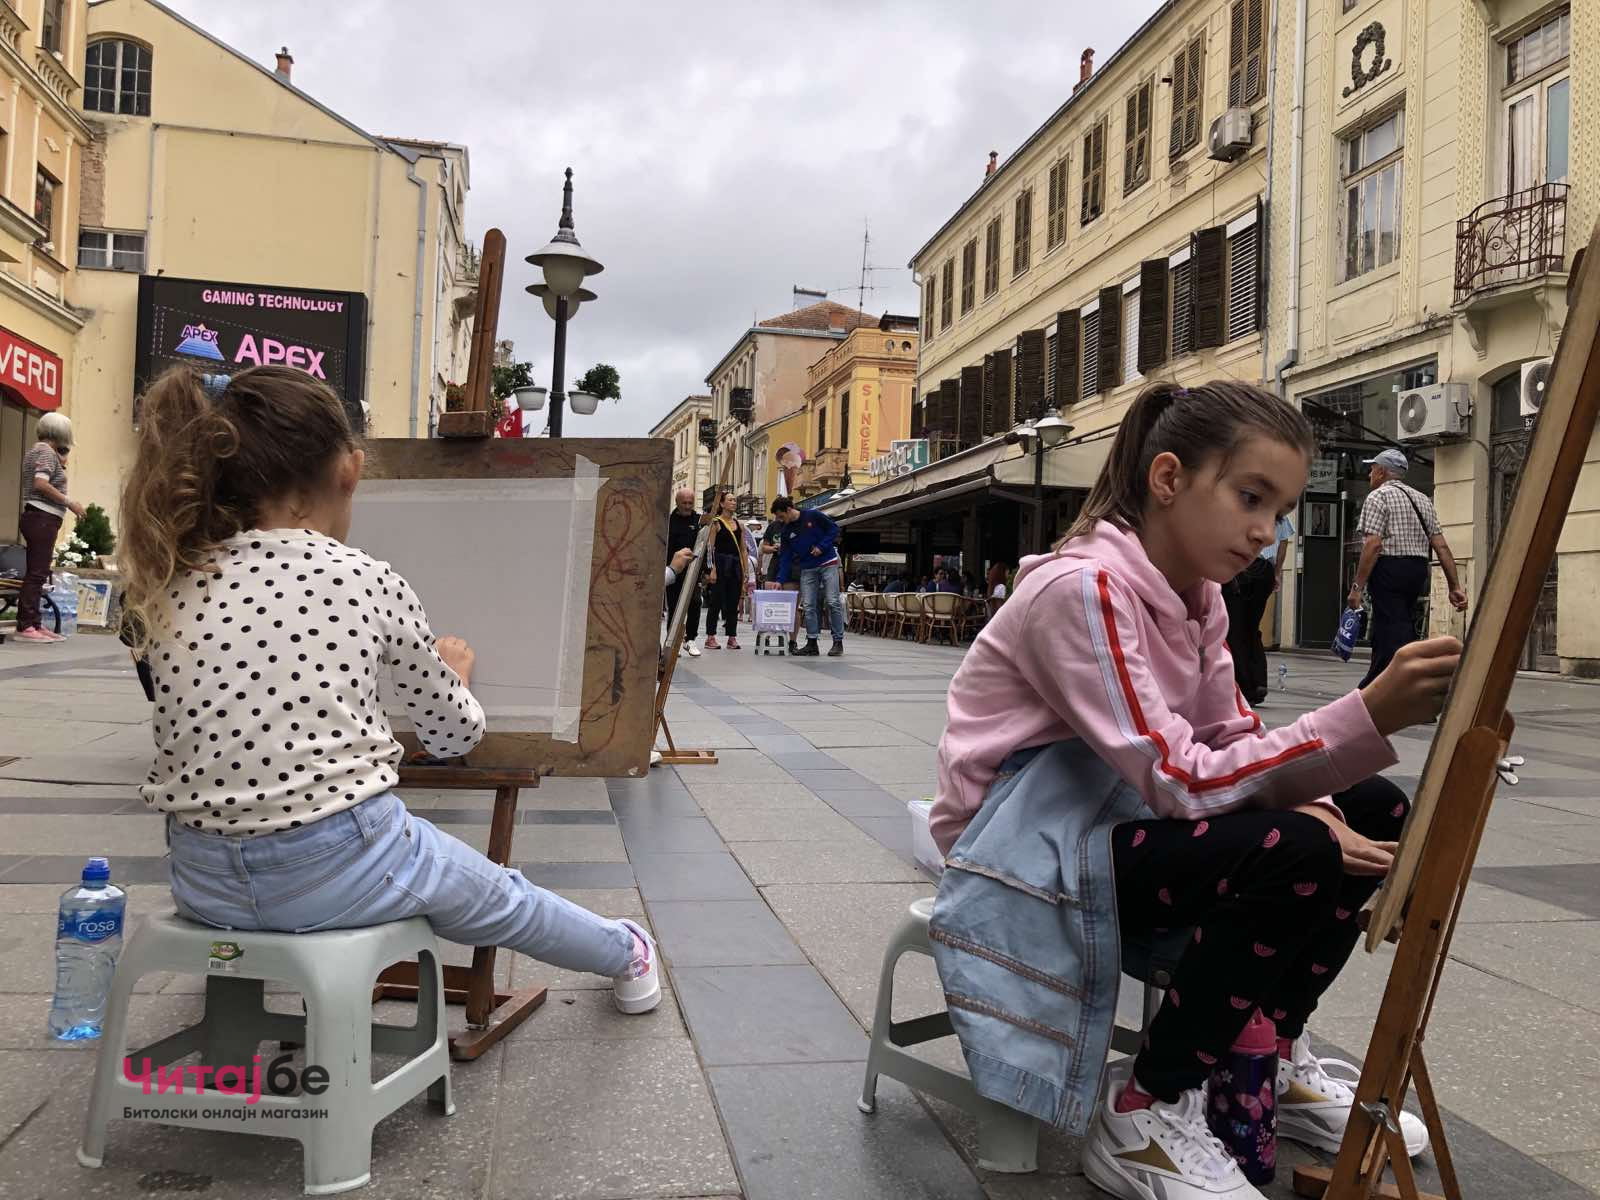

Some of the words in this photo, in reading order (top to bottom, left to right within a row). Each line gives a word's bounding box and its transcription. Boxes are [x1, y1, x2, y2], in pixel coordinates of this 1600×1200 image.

[202, 289, 254, 306] GAMING
[258, 294, 343, 312] TECHNOLOGY
[181, 325, 218, 344] APEX
[0, 343, 57, 396] VERO
[233, 334, 326, 379] APEX
[860, 384, 872, 462] SINGER
[78, 920, 116, 933] rosa
